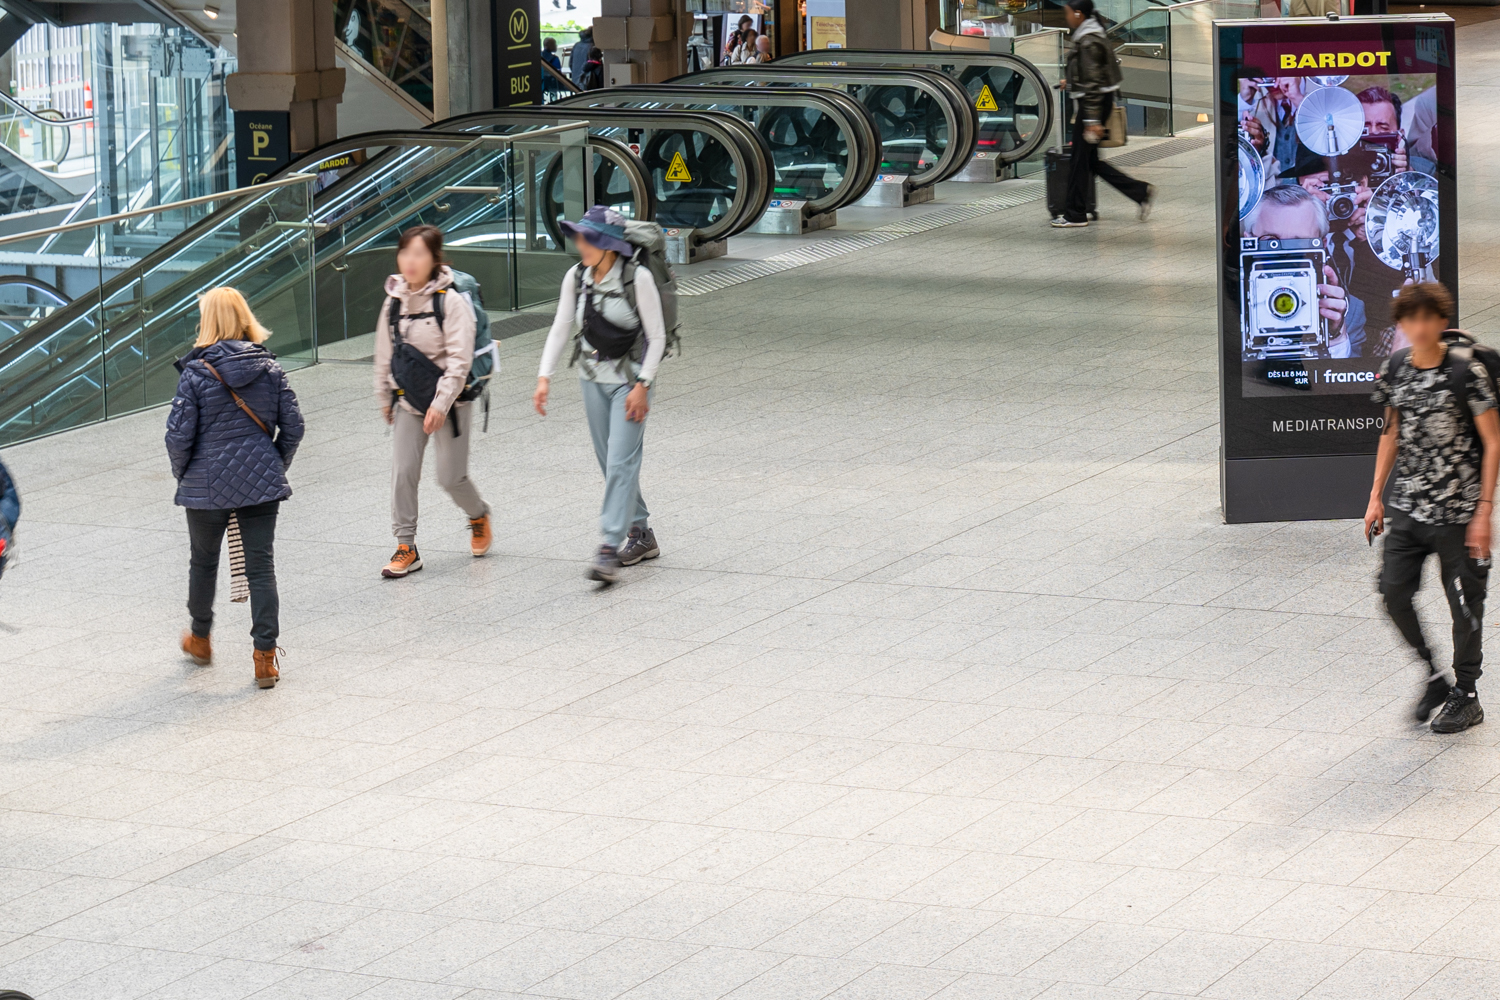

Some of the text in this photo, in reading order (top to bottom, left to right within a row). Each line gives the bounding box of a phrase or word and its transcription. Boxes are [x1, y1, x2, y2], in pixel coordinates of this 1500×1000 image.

[513, 16, 525, 35] M
[1280, 51, 1391, 69] BARDOT
[510, 75, 530, 95] BUS
[249, 122, 272, 130] Océane
[253, 131, 269, 156] P
[320, 157, 350, 169] BARDOT
[1268, 370, 1280, 378] DÈS
[1272, 417, 1384, 432] MEDIATRANSPO
